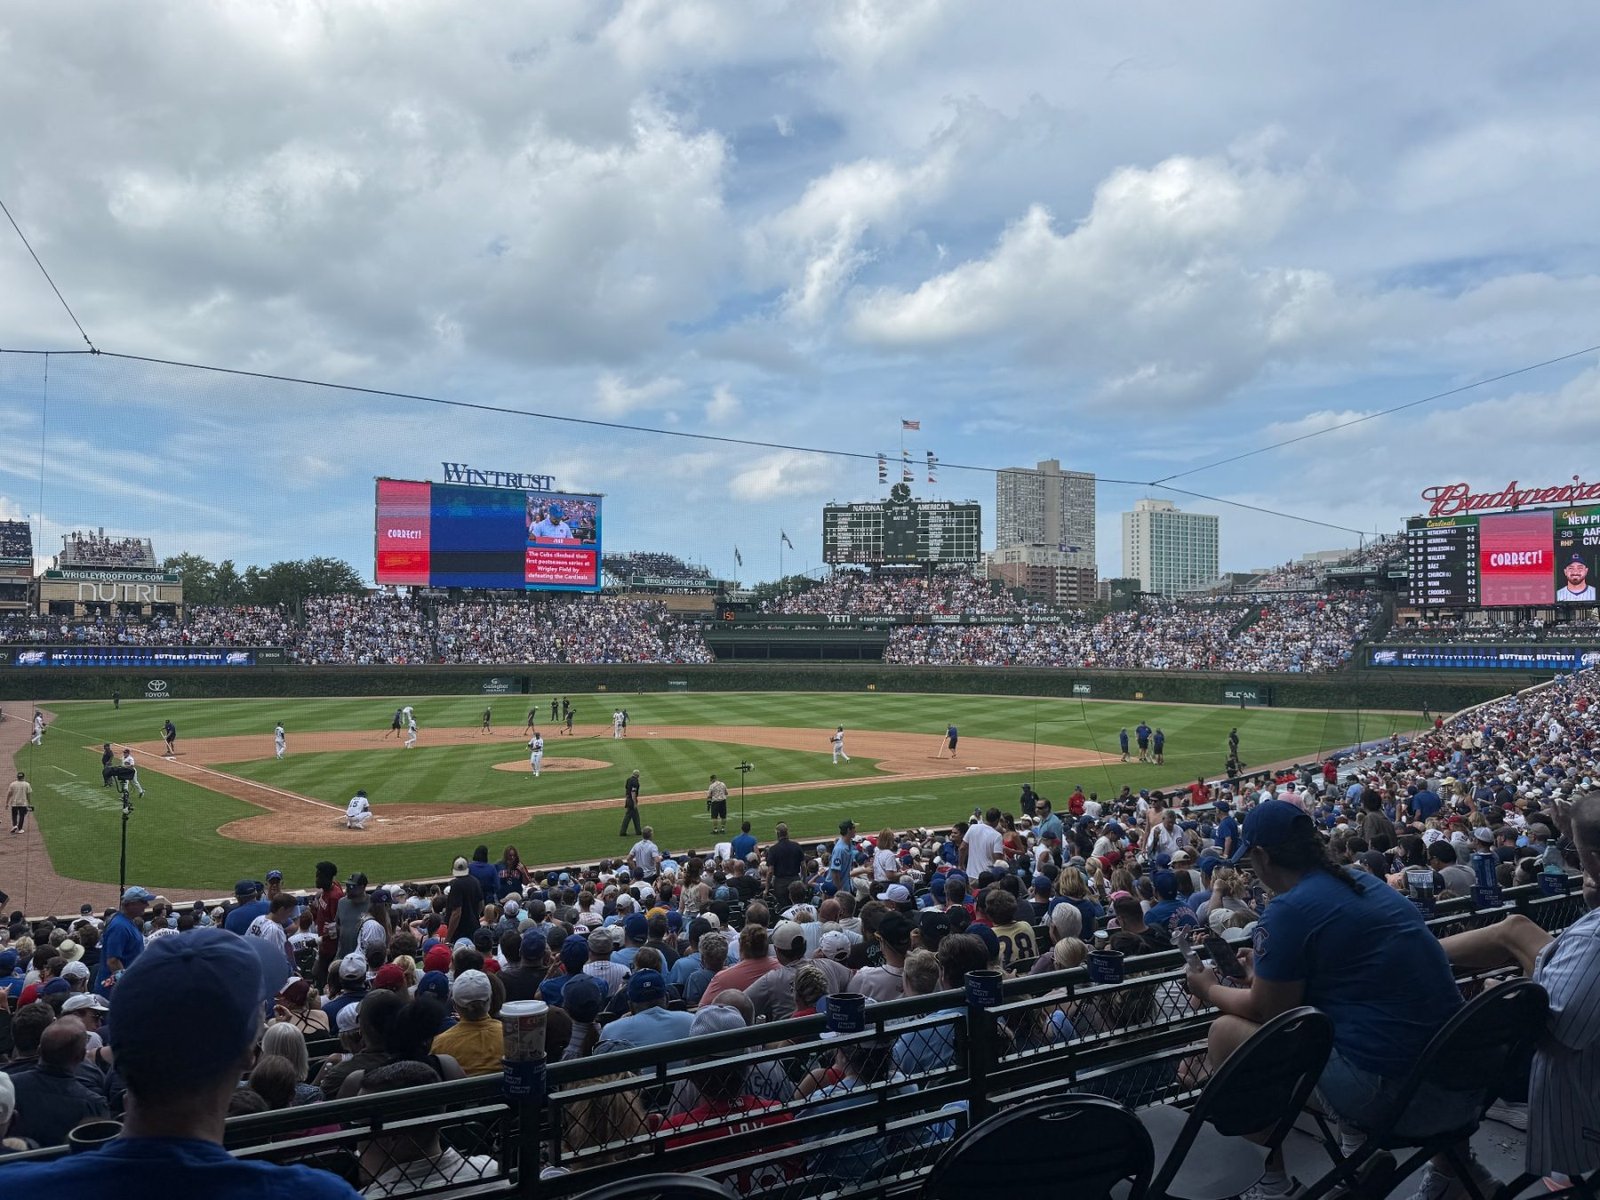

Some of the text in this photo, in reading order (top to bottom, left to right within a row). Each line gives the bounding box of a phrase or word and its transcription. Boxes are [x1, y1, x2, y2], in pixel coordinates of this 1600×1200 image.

[441, 462, 556, 491] WINTRUST
[1426, 518, 1456, 527] Cardinals
[1568, 516, 1589, 525] NEW
[388, 529, 422, 539] CORRECT!
[1490, 550, 1543, 567] CORRECT!
[62, 571, 164, 580] WRIGLEYROOFTOPS.COM
[1536, 652, 1575, 660] BUTTERY!
